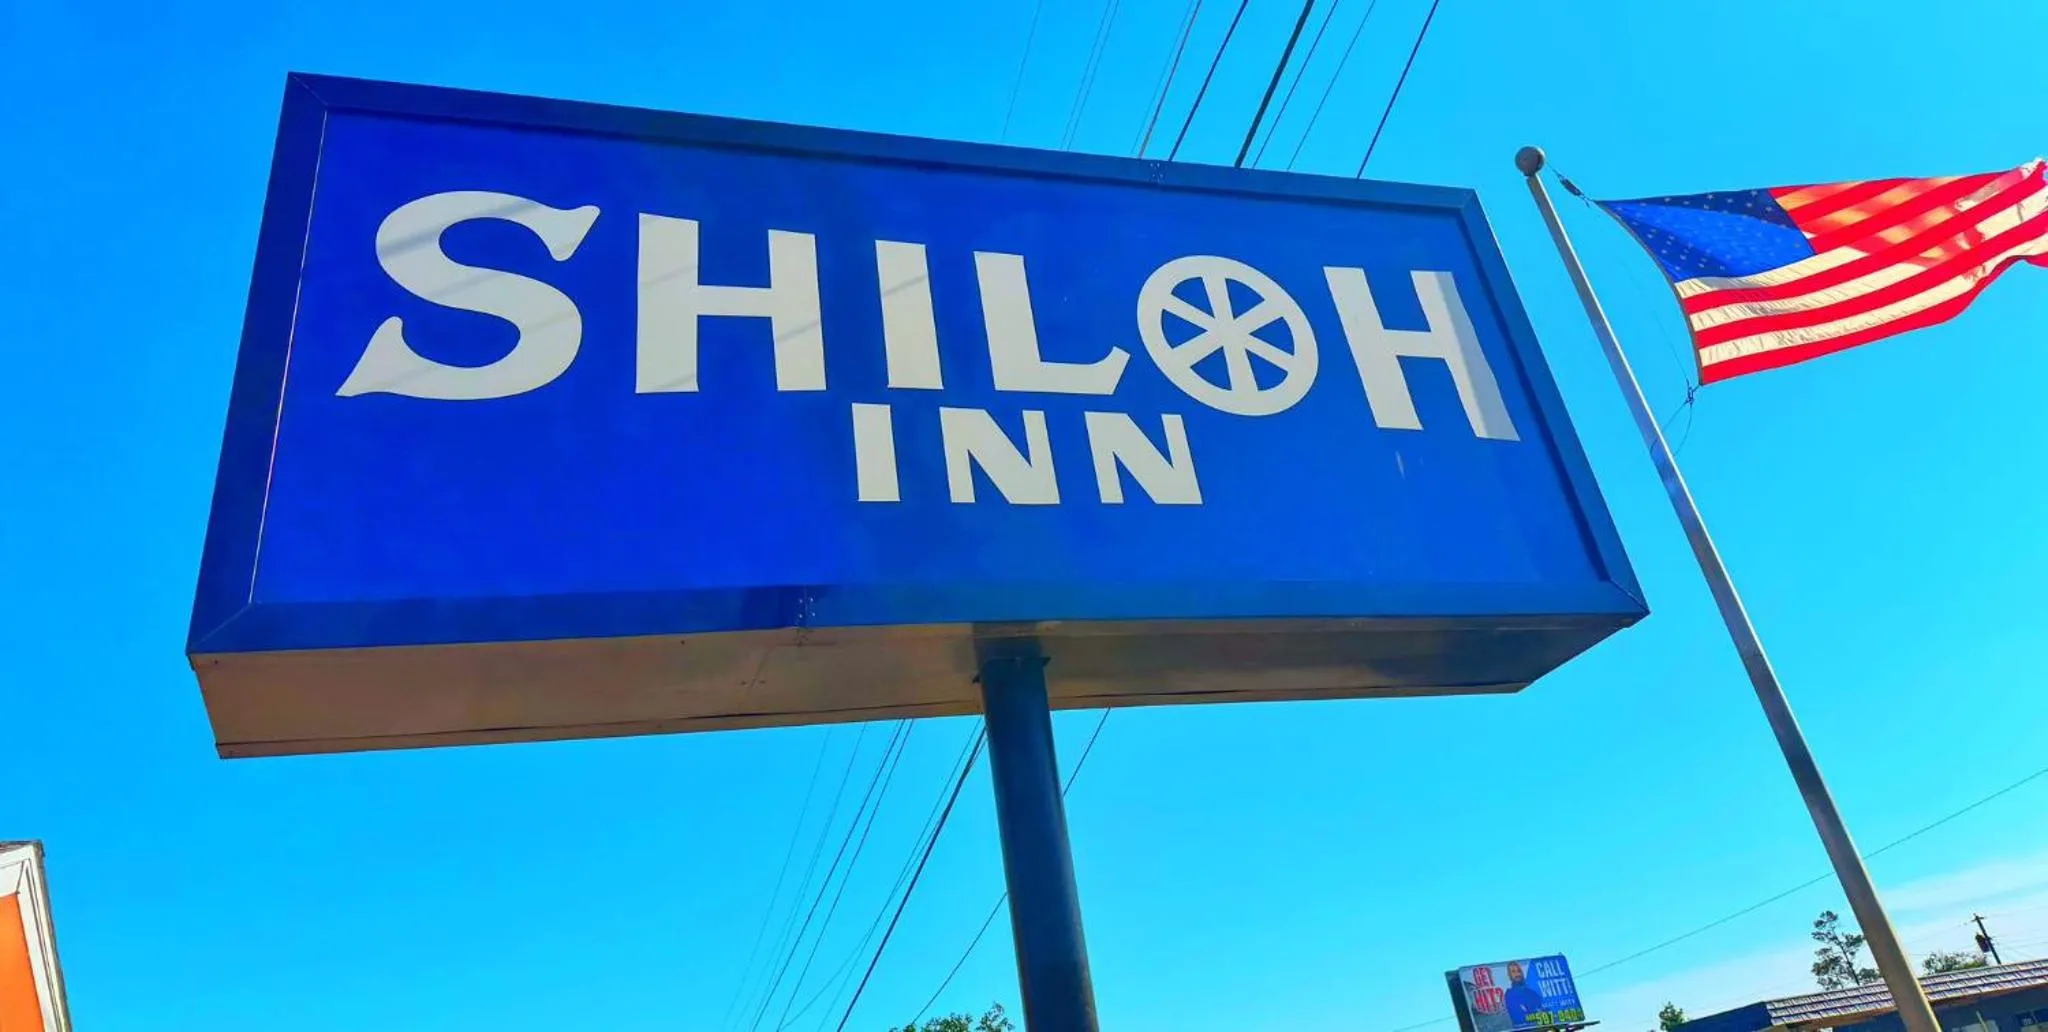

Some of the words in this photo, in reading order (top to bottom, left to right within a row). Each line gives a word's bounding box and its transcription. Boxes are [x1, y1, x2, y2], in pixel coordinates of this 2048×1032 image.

[336, 190, 1520, 440] SHILOH
[852, 402, 1203, 505] INN
[1473, 967, 1492, 989] GET
[1535, 960, 1564, 978] CALL
